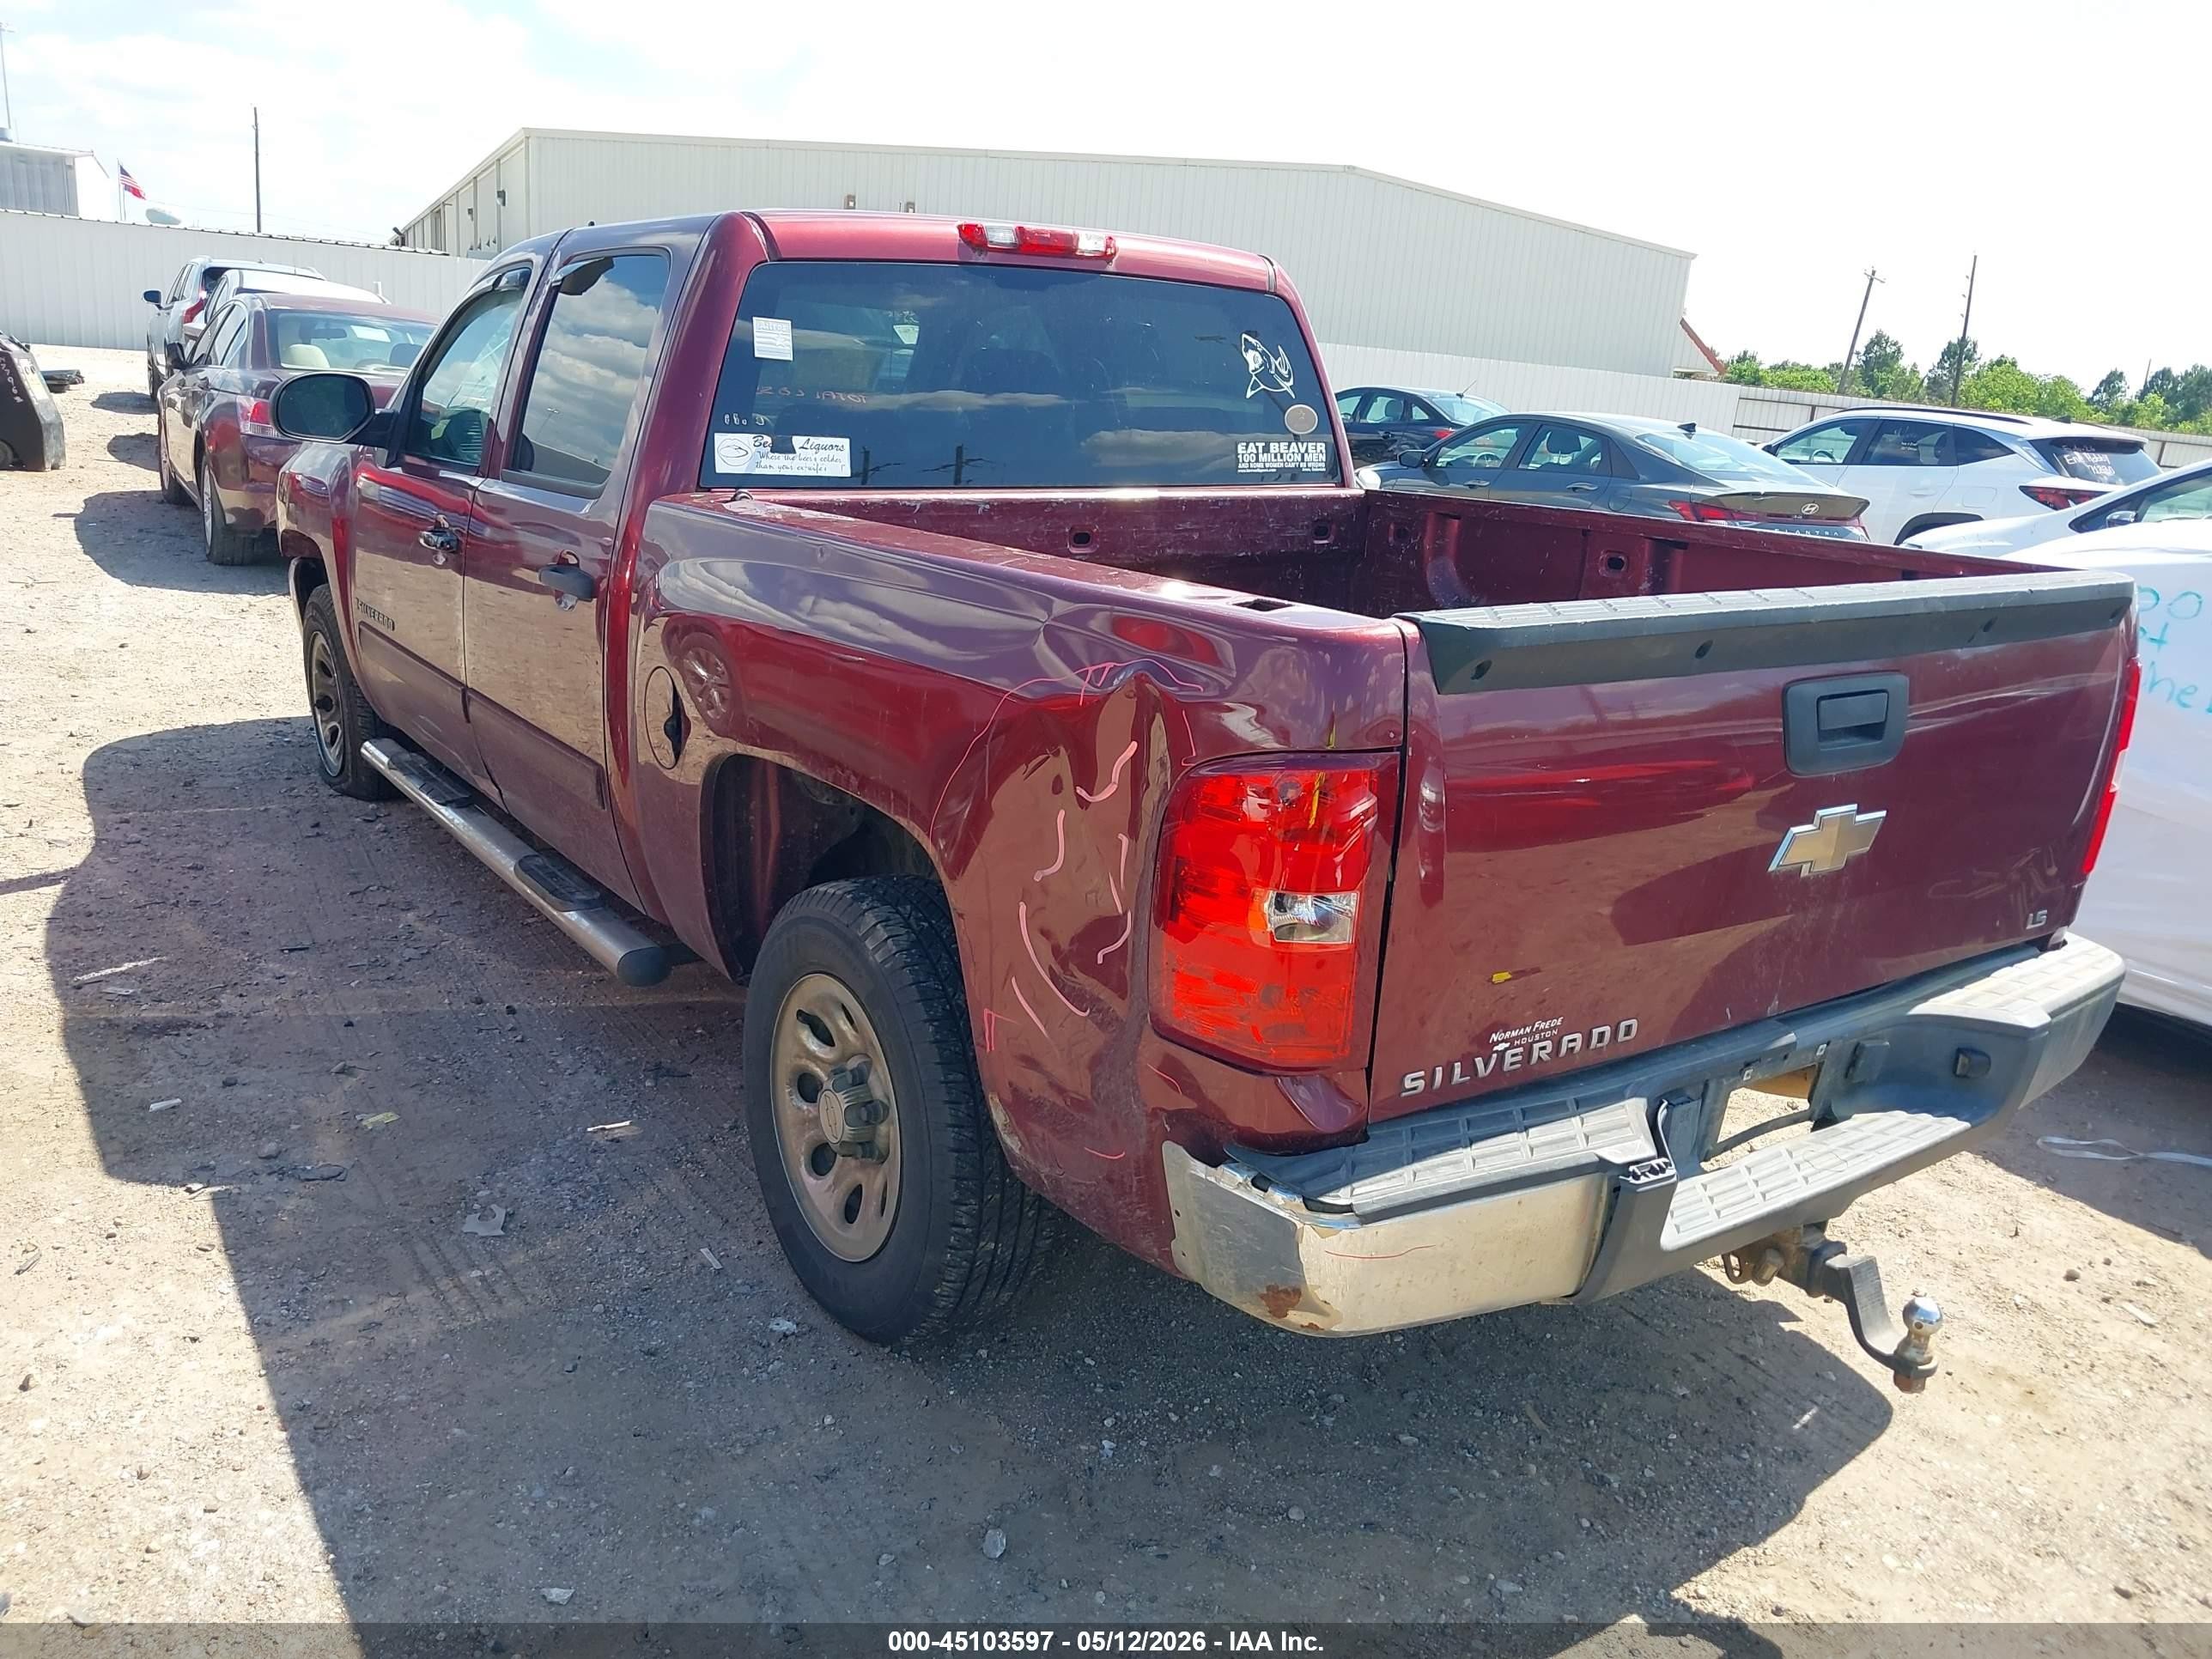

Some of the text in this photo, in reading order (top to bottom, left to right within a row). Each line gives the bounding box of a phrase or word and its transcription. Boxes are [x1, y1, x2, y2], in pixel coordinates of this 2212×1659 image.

[799, 438, 845, 453] Liquors
[1237, 442, 1326, 453] EAT BEAVER
[1237, 453, 1326, 463] 100 MILLION MEN
[2026, 909, 2048, 929] LS
[1489, 1017, 1565, 1044] NORMAN FREDE
[1513, 1028, 1559, 1047] HOUSTON
[1401, 1018, 1639, 1097] SILVERADO
